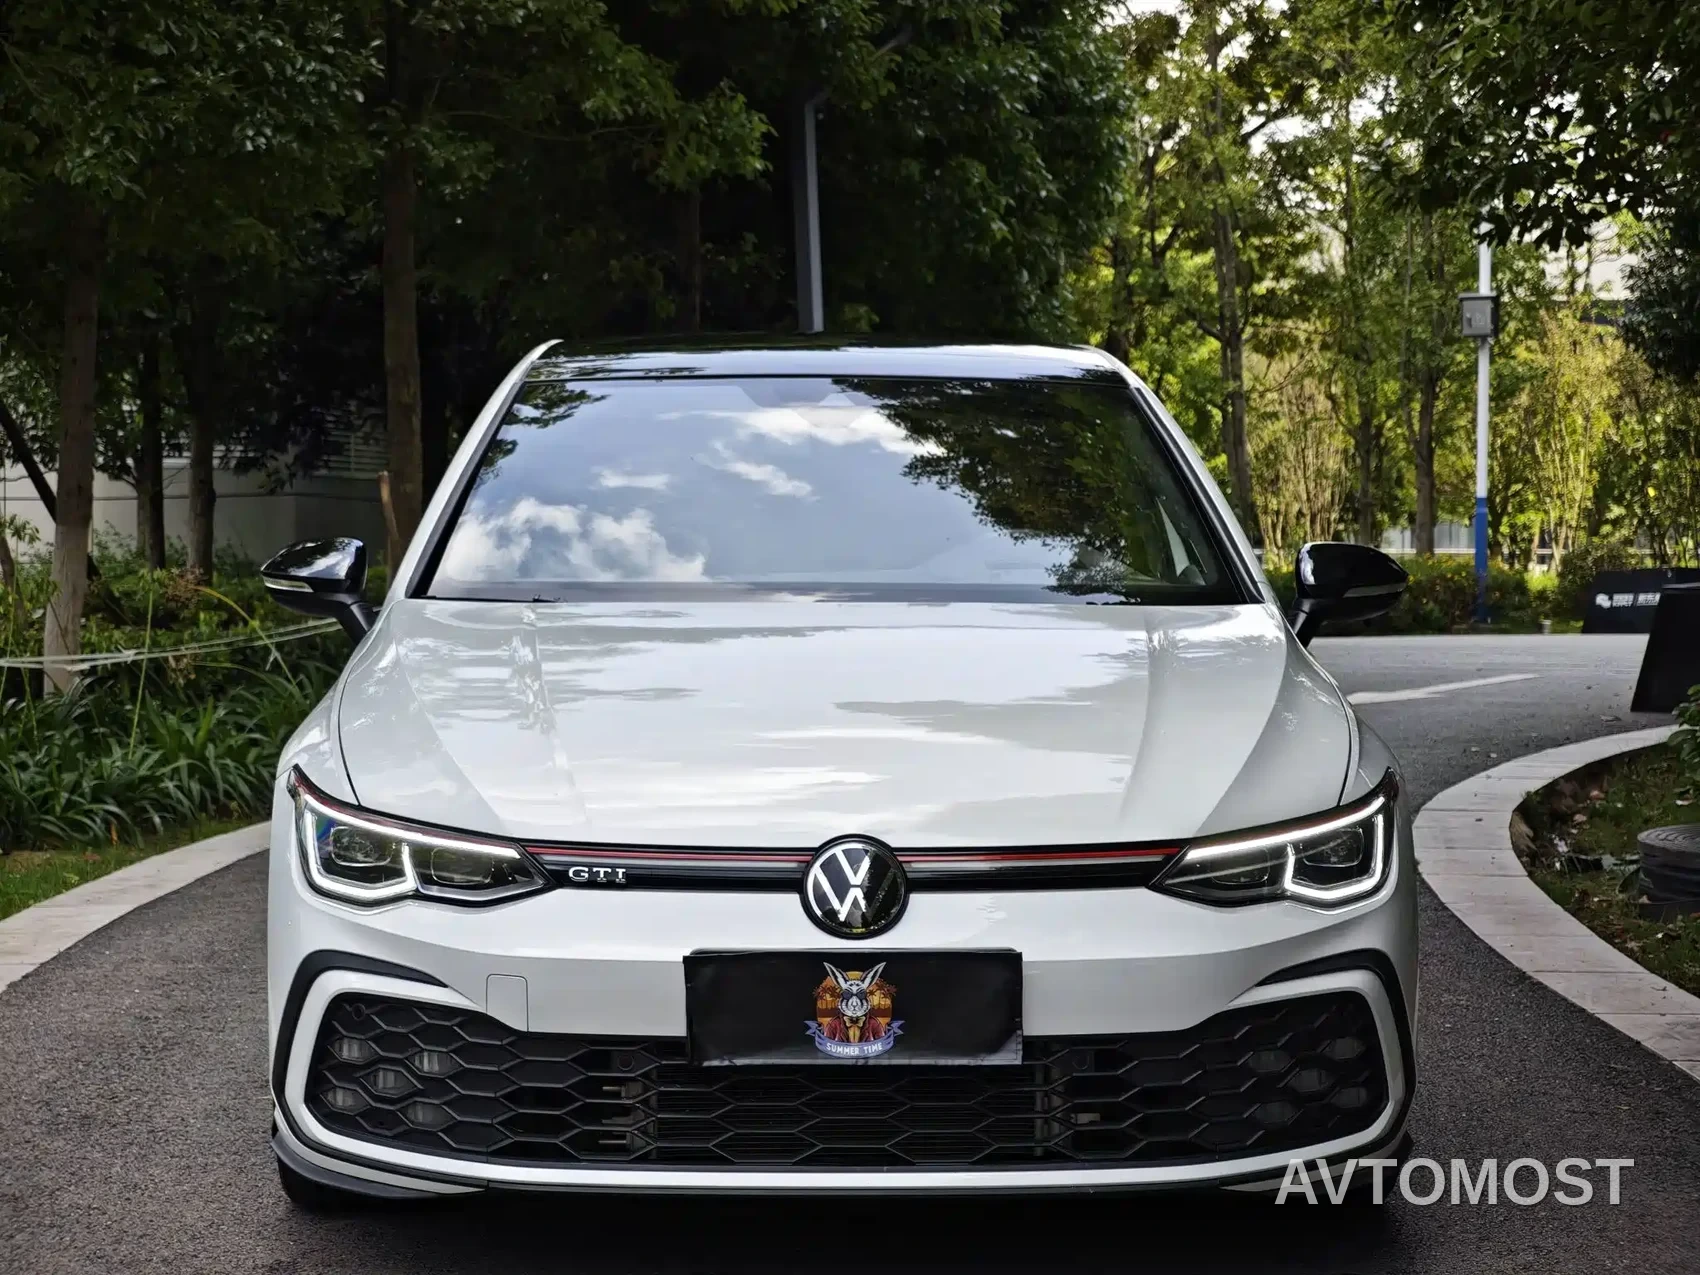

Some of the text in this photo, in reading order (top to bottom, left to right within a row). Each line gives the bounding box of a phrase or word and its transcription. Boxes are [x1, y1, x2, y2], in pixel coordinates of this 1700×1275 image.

[568, 866, 627, 883] GTI
[826, 1042, 883, 1055] SUMMER TIME
